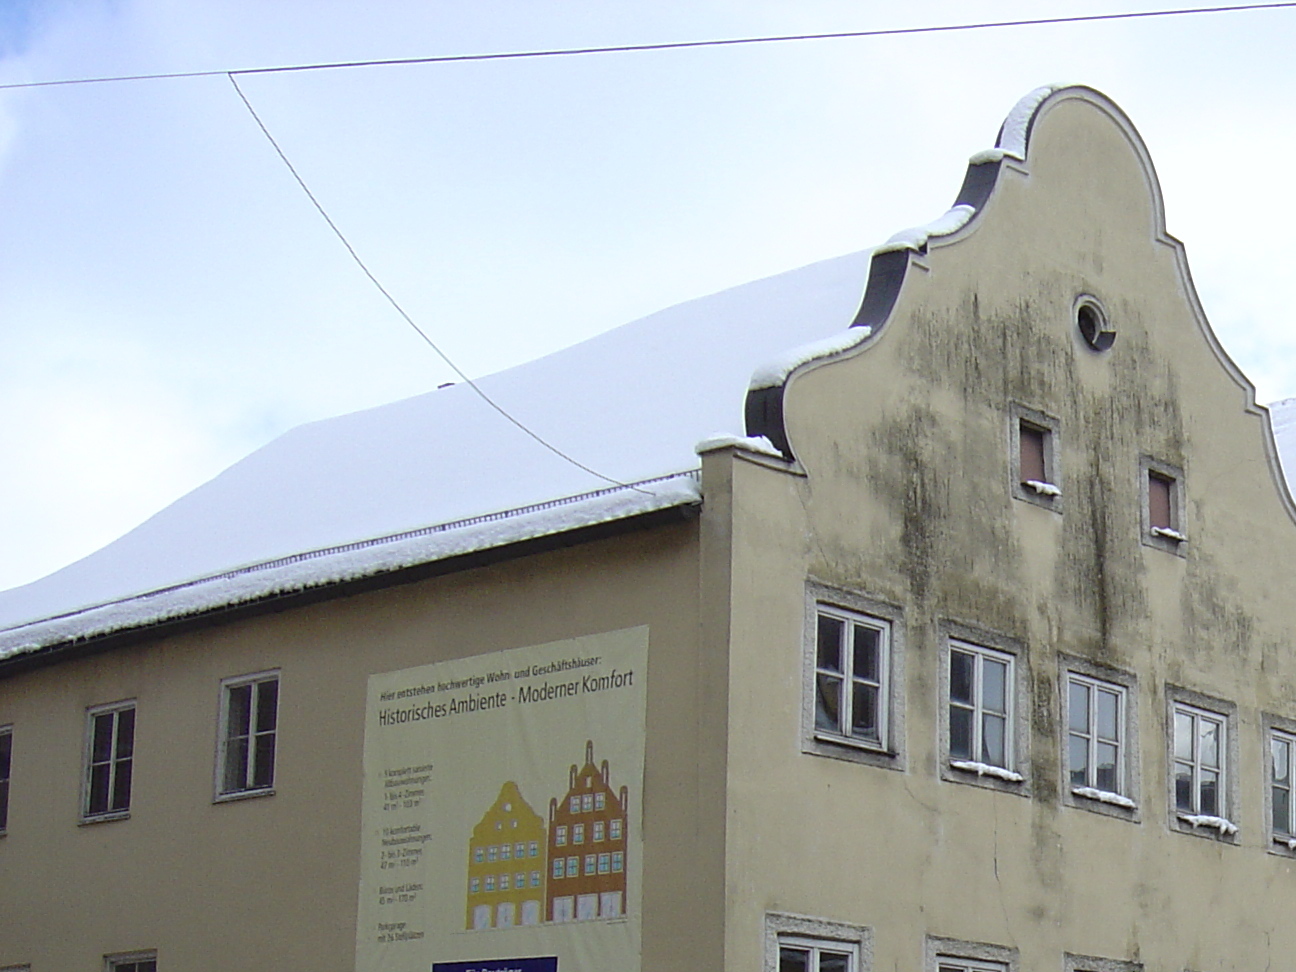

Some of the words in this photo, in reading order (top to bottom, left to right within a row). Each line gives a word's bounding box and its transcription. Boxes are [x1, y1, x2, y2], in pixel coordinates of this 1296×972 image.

[379, 701, 447, 727] Historisches
[448, 692, 507, 716] Ambiente
[518, 681, 579, 704] Moderner
[582, 669, 633, 693] Komfort
[380, 690, 395, 702] Hier
[397, 684, 435, 699] entstehen
[437, 675, 485, 692] hochwertige
[514, 666, 530, 679] und
